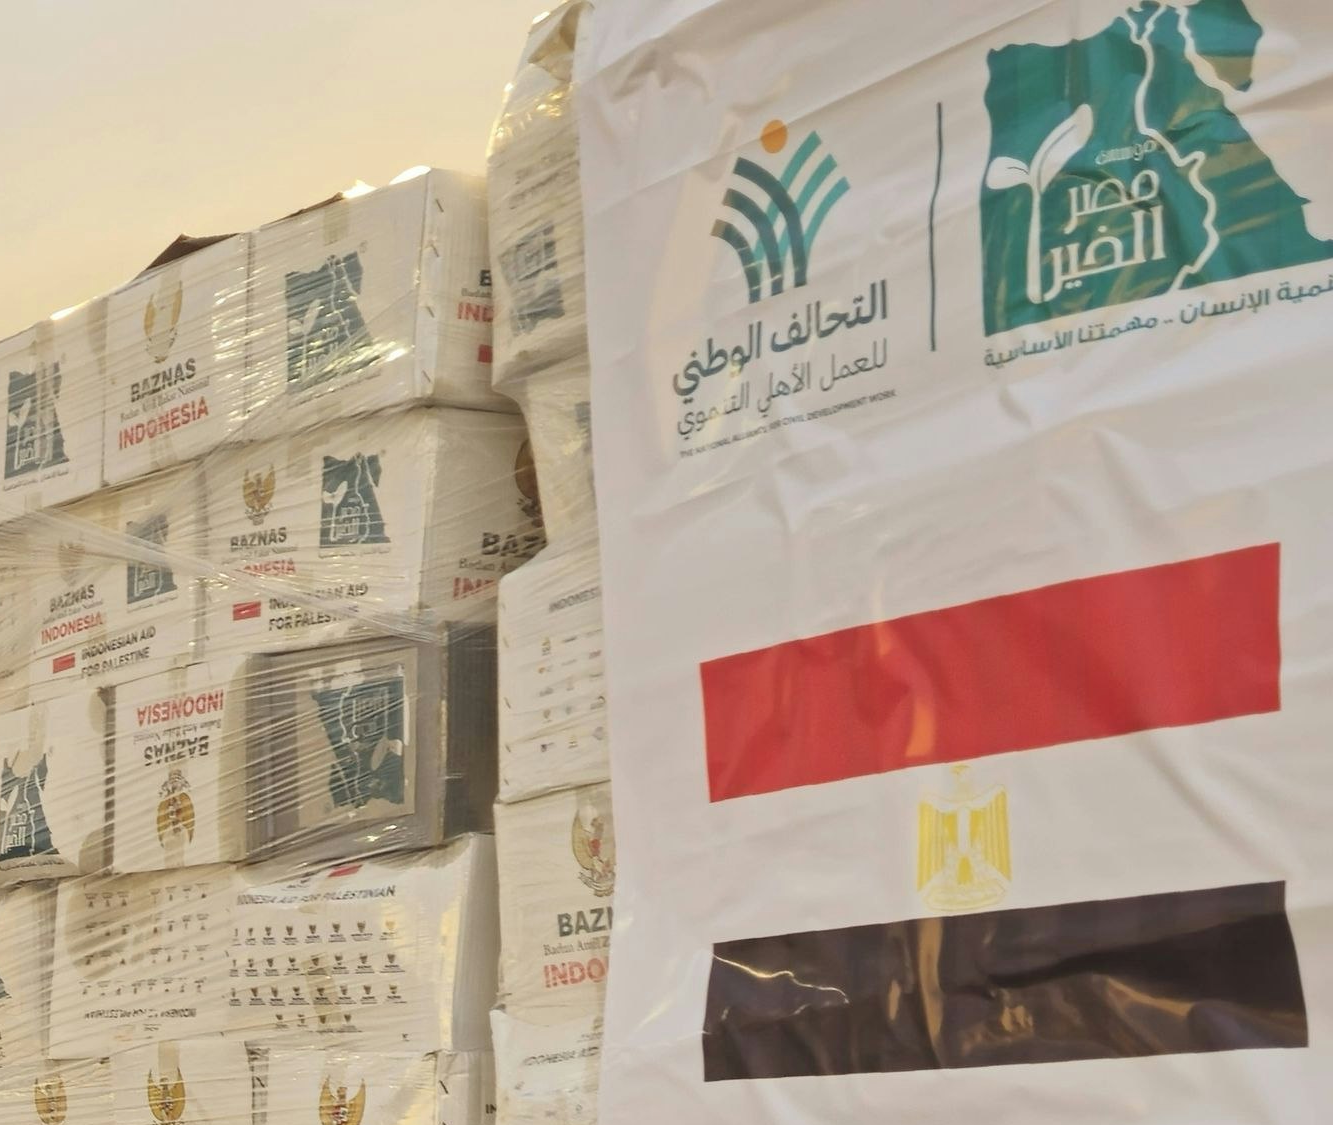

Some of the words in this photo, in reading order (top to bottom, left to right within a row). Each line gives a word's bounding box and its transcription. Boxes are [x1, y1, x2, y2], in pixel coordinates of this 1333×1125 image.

[1064, 169, 1159, 234] مصر
[1041, 206, 1167, 302] الخير
[770, 279, 888, 352] التحالف
[1276, 272, 1333, 304] نمية
[130, 357, 197, 403] BAZNAS
[673, 320, 763, 404] الوطني
[757, 360, 811, 418] الأهلي
[819, 337, 888, 392] للعمل
[119, 396, 210, 450] INDONESIA
[137, 688, 225, 728] INDONESIA
[542, 956, 609, 989] INDO
